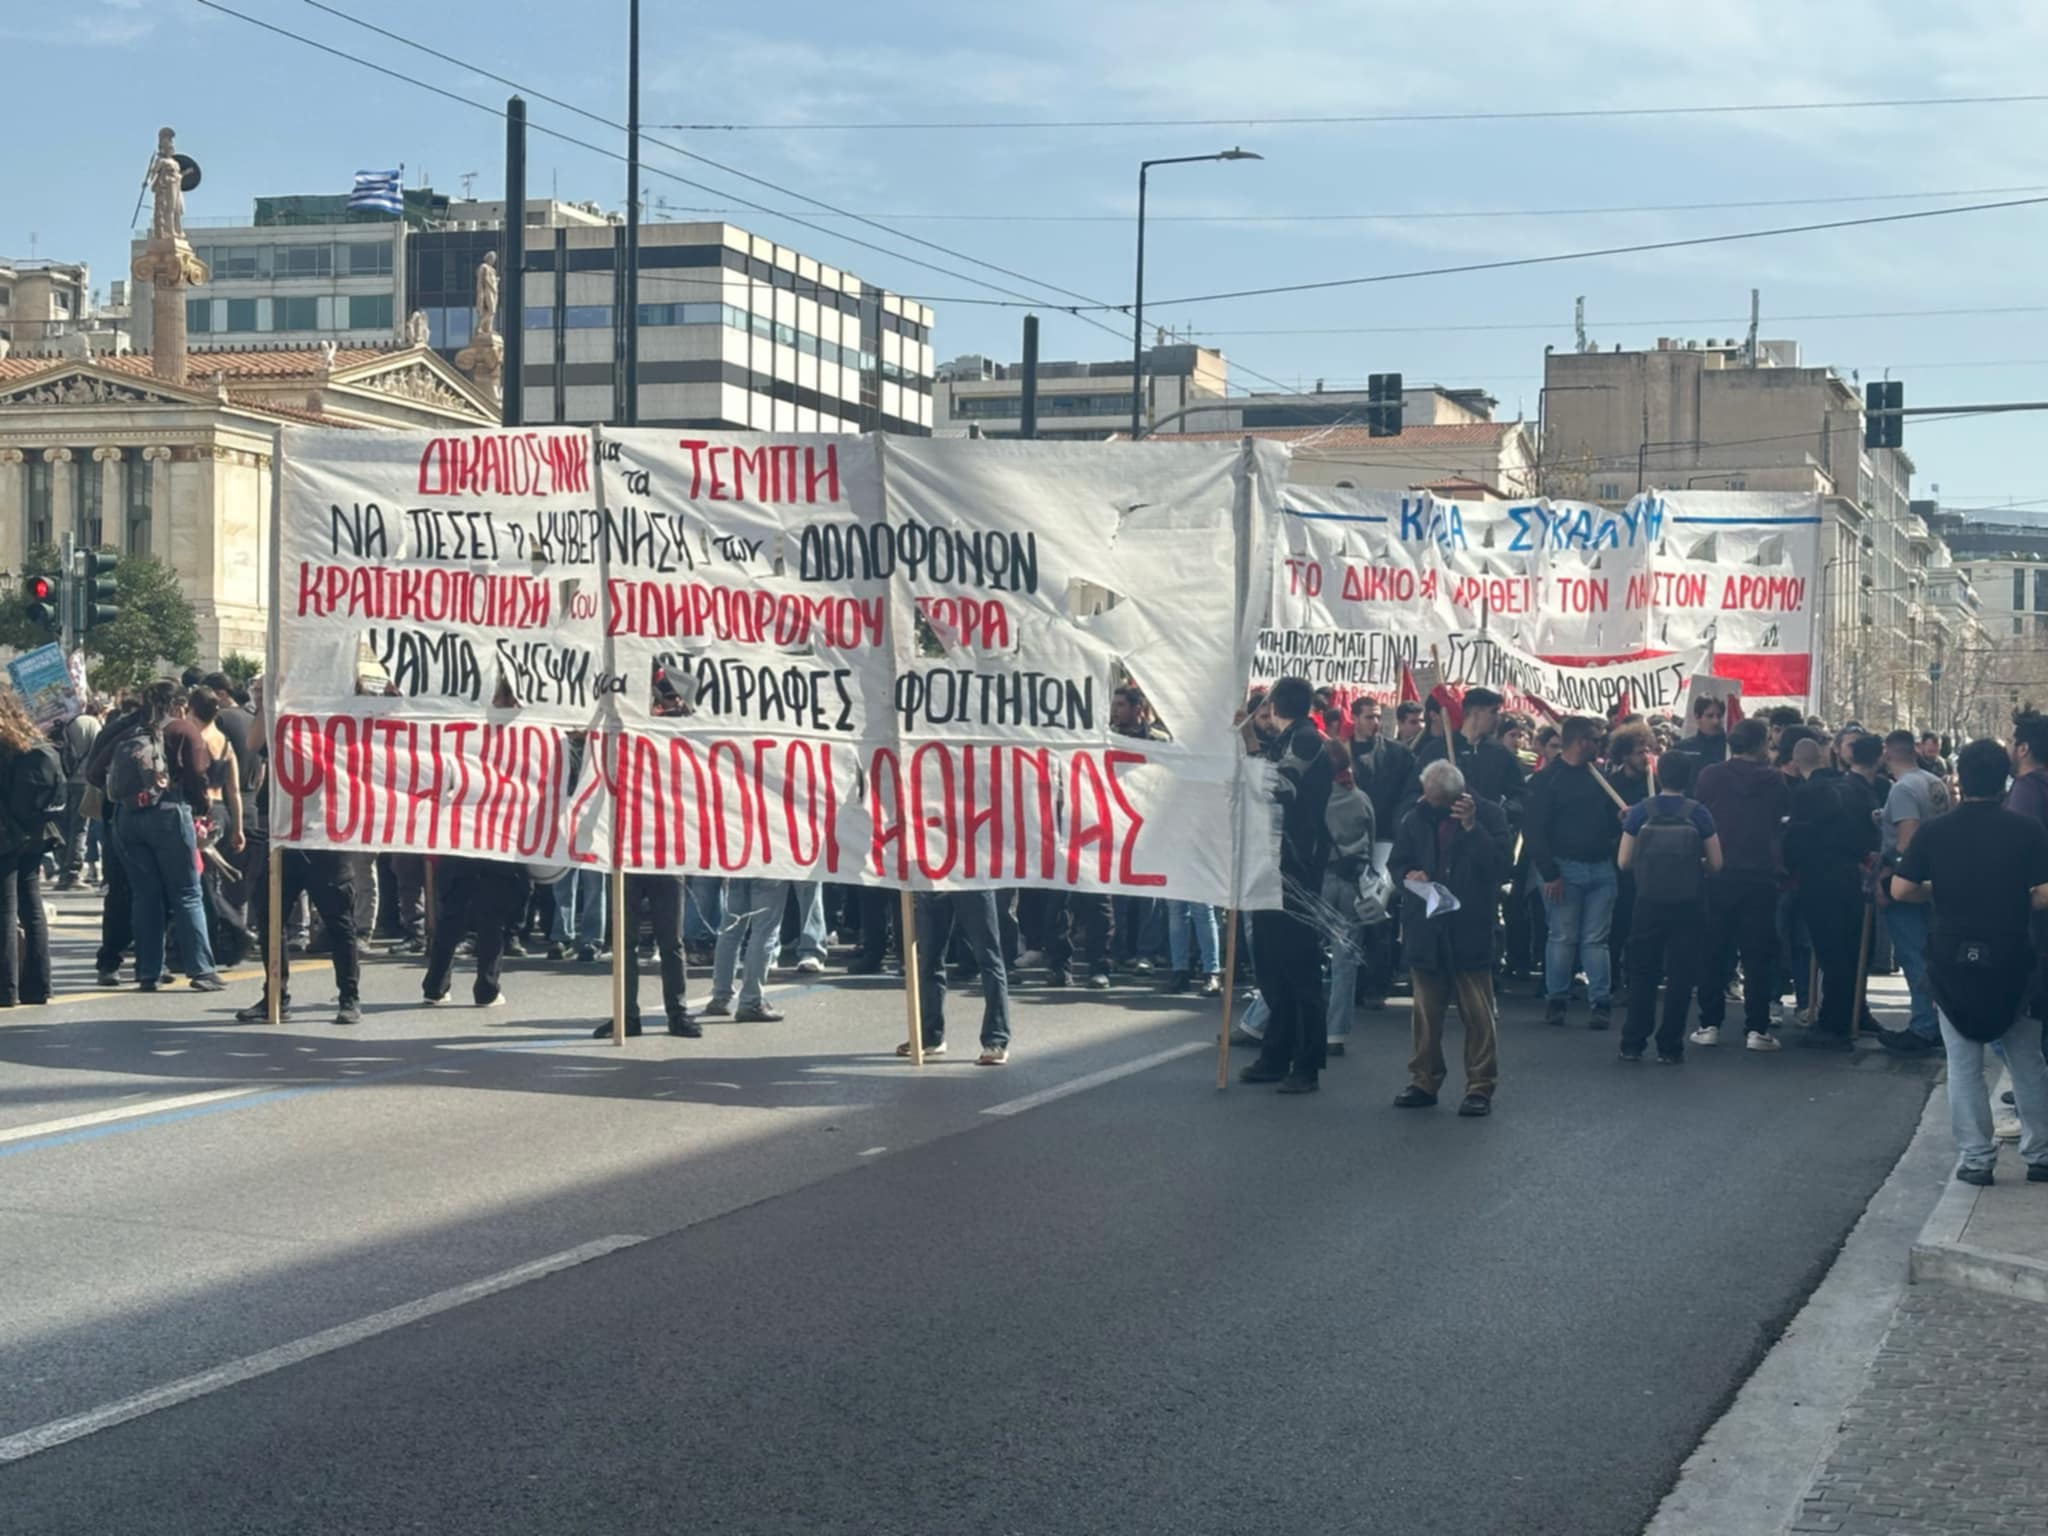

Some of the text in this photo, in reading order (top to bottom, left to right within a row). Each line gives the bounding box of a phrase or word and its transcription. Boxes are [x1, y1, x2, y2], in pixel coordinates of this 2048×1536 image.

[418, 433, 839, 503] ΔΙΚΑΙΟΣΥΝΗ για τα ΤΕΜΠΗ
[331, 504, 1038, 594] ΝΑ ΠΕΣΕΙ η ΚΥΒΕΡΝΗΣΗ των ΔΟΛΟΦΟΝΩΝ
[298, 561, 550, 629] ΚΡΑΤΙΚΟΠΟΙΗΣΗ
[607, 578, 884, 650] ΣΙΔΗΡΟΔΡΟΜΟΥ
[1285, 559, 1322, 597] ΤΟ
[1342, 565, 1415, 602] ΔΙΚΙΟ
[1557, 578, 1609, 613] ΤΟΝ
[1720, 576, 1805, 613] ΔΡΟΜΟ!
[1333, 632, 1366, 659] ΜΑΤΙ
[895, 668, 1093, 731] ΦΟΙΤΗΤΩΝ
[275, 714, 1167, 886] ΦΟΙΤΗΤΙΚΟΙ ΣΥΛΛΟΓΟΙ ΑΘΗΝΑΣ
